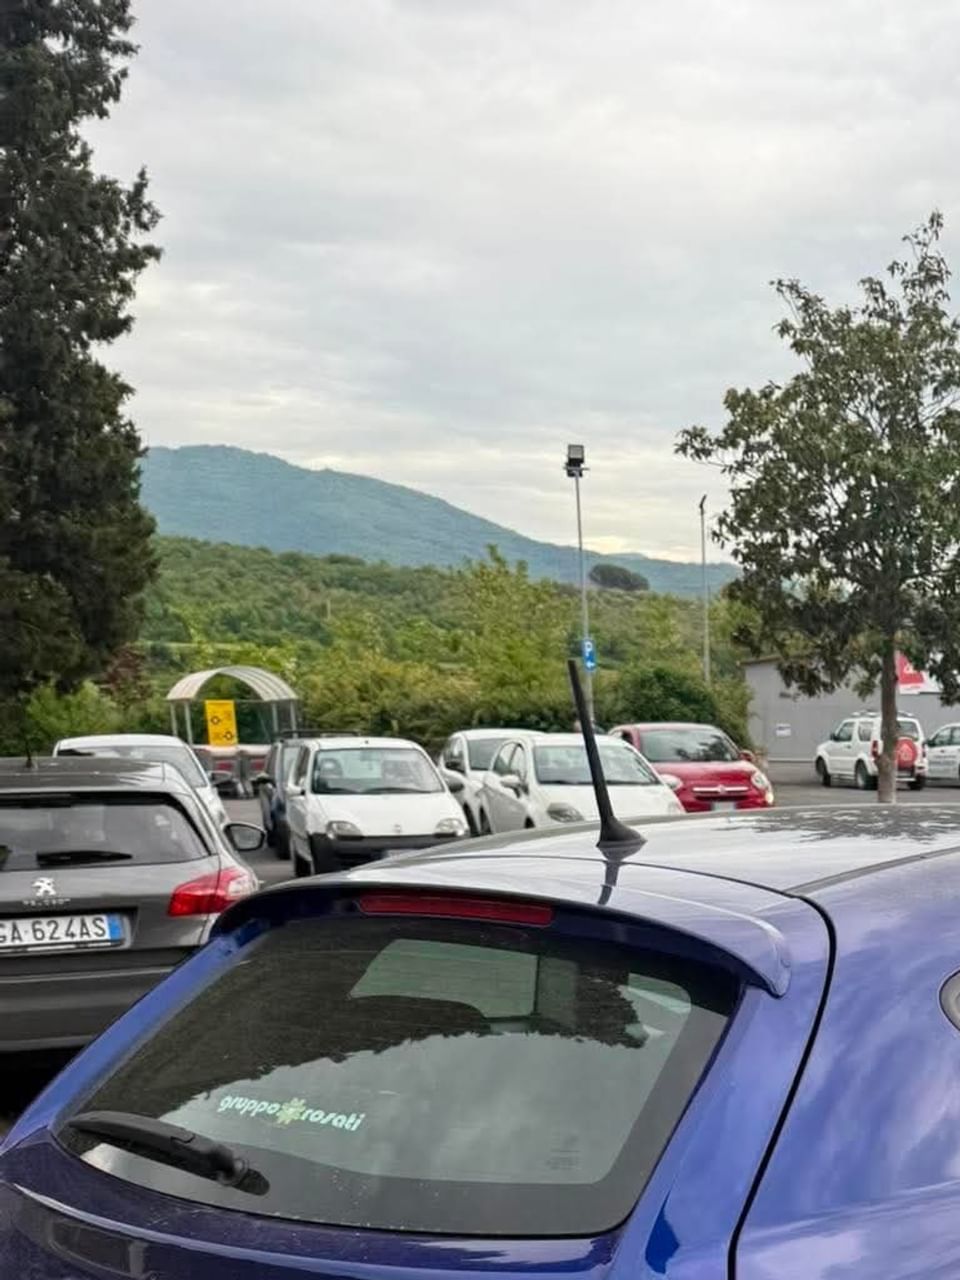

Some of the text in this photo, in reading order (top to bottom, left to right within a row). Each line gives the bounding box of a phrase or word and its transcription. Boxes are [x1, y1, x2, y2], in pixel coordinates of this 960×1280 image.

[31, 917, 106, 941] 624AS
[217, 1095, 366, 1131] gruppo rosati
